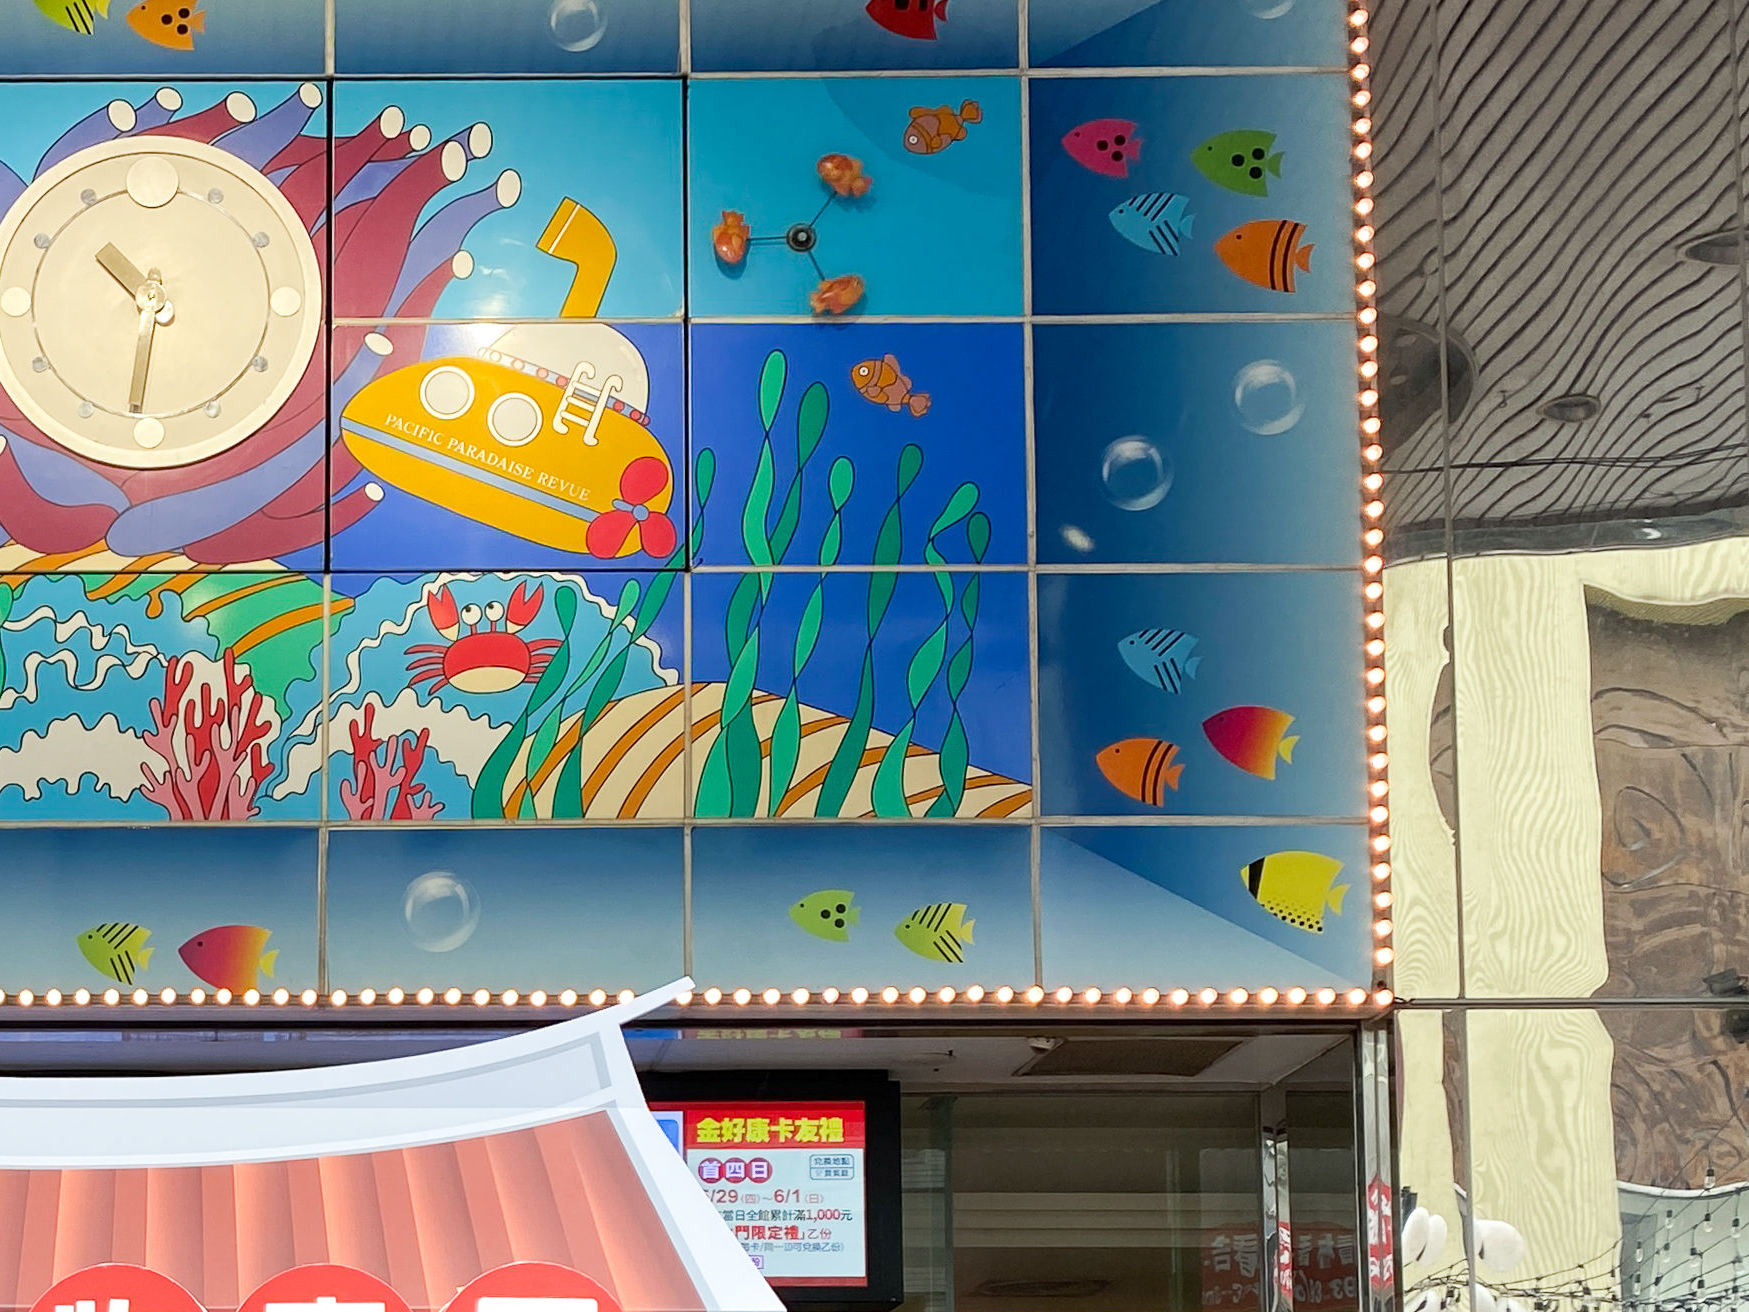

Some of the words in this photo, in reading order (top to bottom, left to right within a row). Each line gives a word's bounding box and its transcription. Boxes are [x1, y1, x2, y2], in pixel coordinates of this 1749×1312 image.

[384, 412, 445, 447] PACIFIC
[446, 437, 535, 481] PARADAISE
[536, 471, 592, 502] REVUE
[696, 1116, 845, 1144] 金好康卡友禮
[719, 1209, 854, 1223] 當日全館累計滿1,000元
